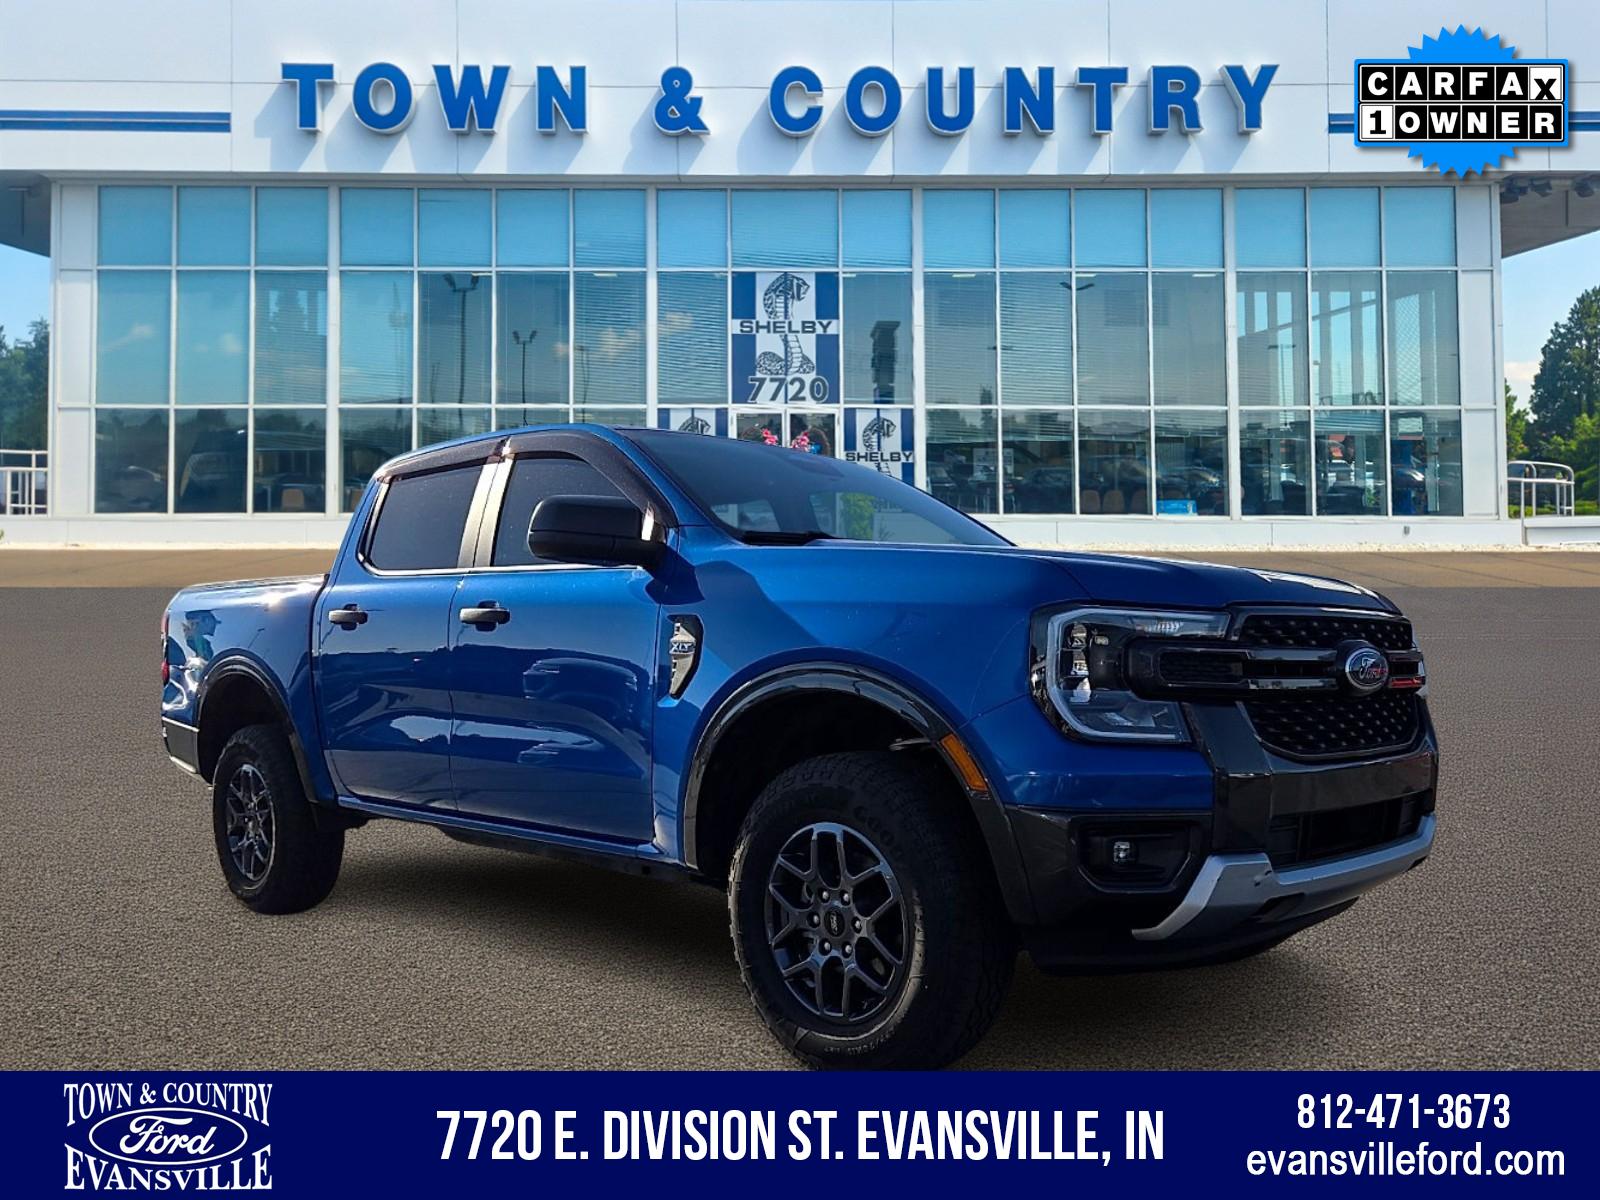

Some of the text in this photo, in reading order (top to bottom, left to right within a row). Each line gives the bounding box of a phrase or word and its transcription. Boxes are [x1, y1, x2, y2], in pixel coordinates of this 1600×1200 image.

[281, 62, 1280, 136] TOWN & COUNTRY
[739, 320, 833, 334] SHELBY
[748, 376, 829, 402] 7720
[845, 452, 913, 462] SHELBY
[671, 641, 692, 651] XLT
